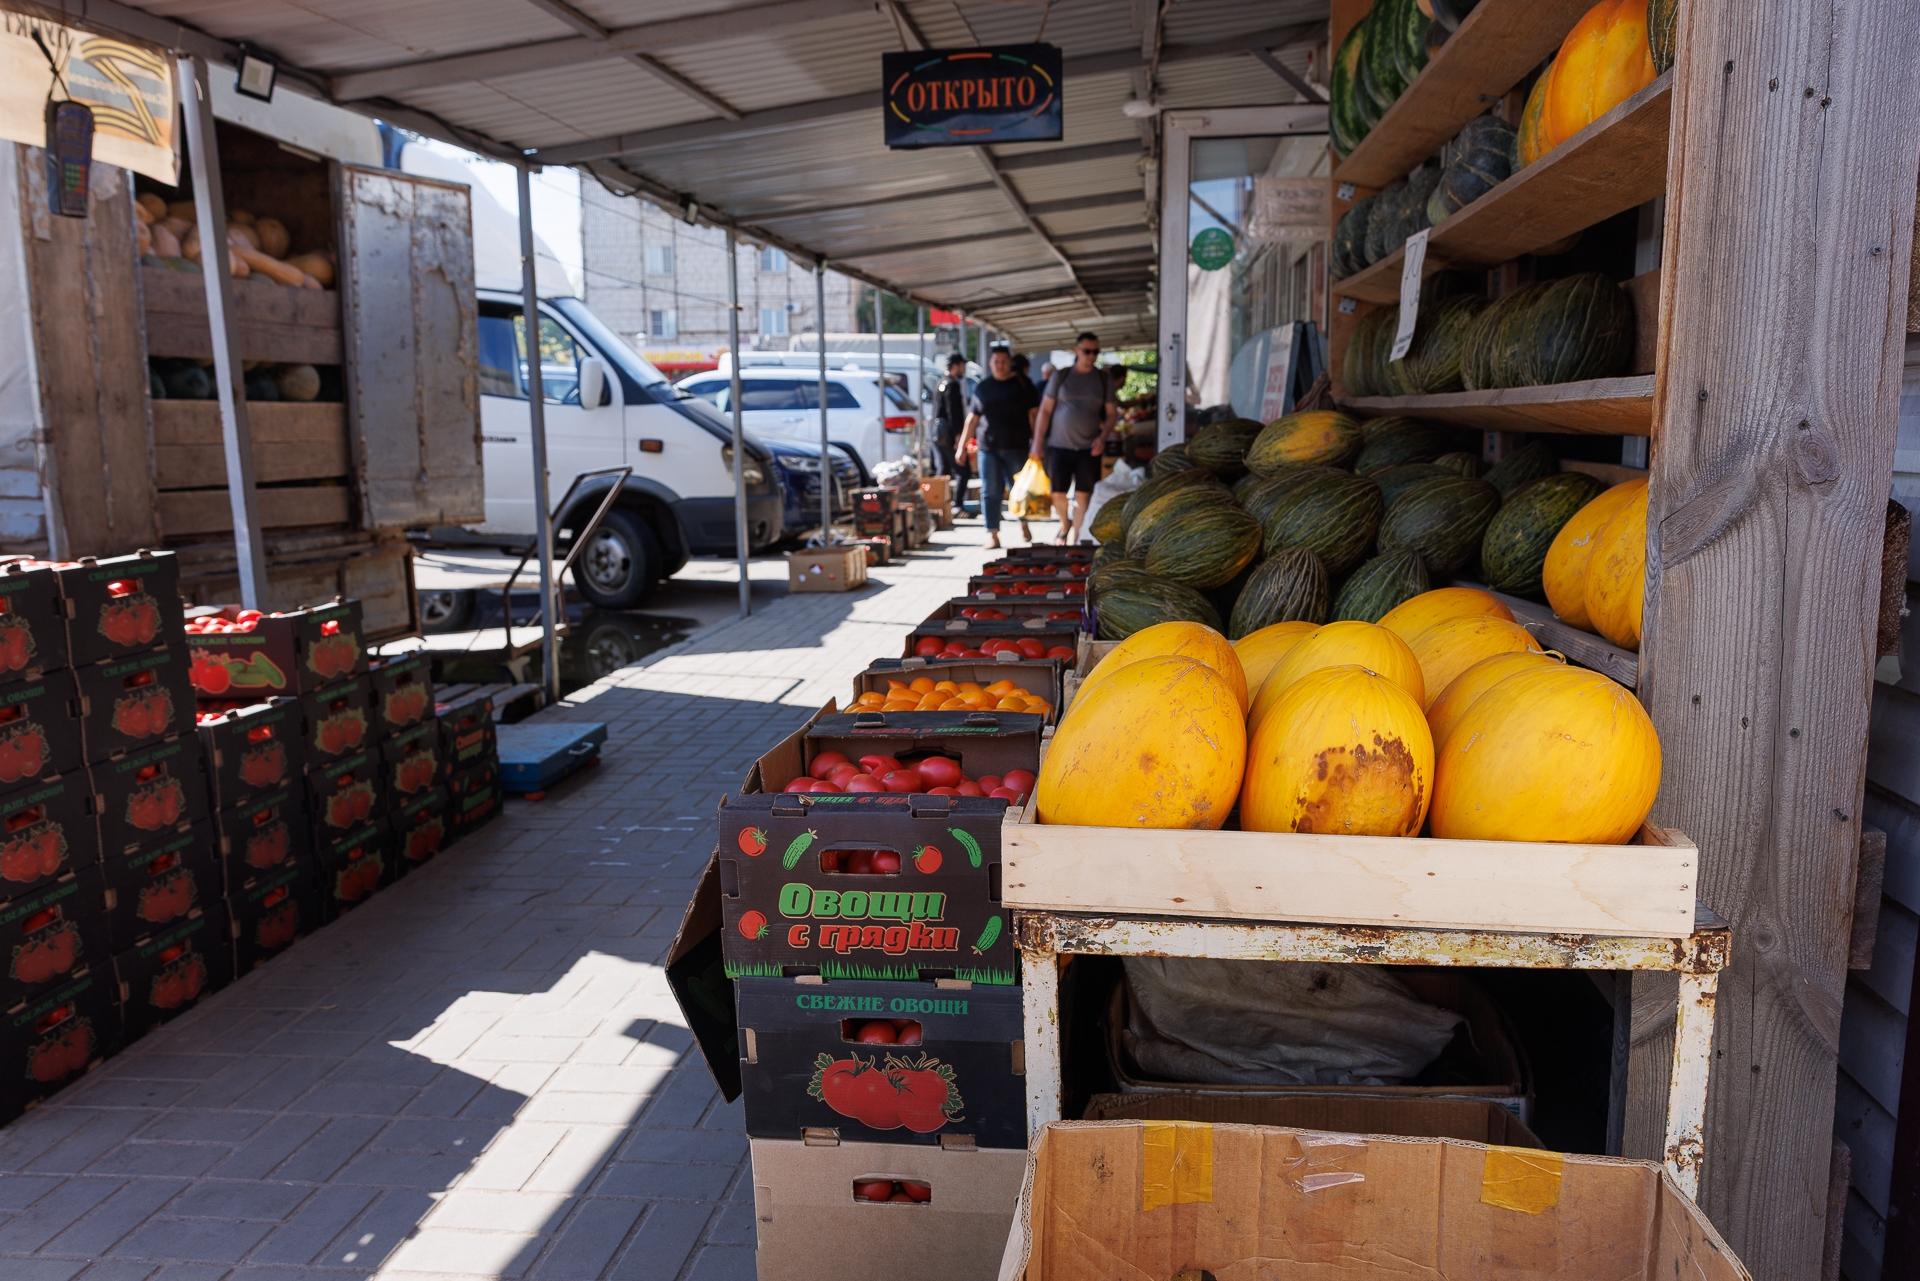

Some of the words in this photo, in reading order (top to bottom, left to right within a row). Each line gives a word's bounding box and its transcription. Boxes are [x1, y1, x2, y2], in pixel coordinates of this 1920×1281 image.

[907, 76, 1036, 112] ОТКРЫТО
[778, 882, 947, 923] Овощи
[788, 924, 810, 948] с
[818, 921, 960, 955] грядки
[796, 994, 885, 1012] СВЕЖИЕ
[890, 998, 969, 1016] ОВОЩИ
